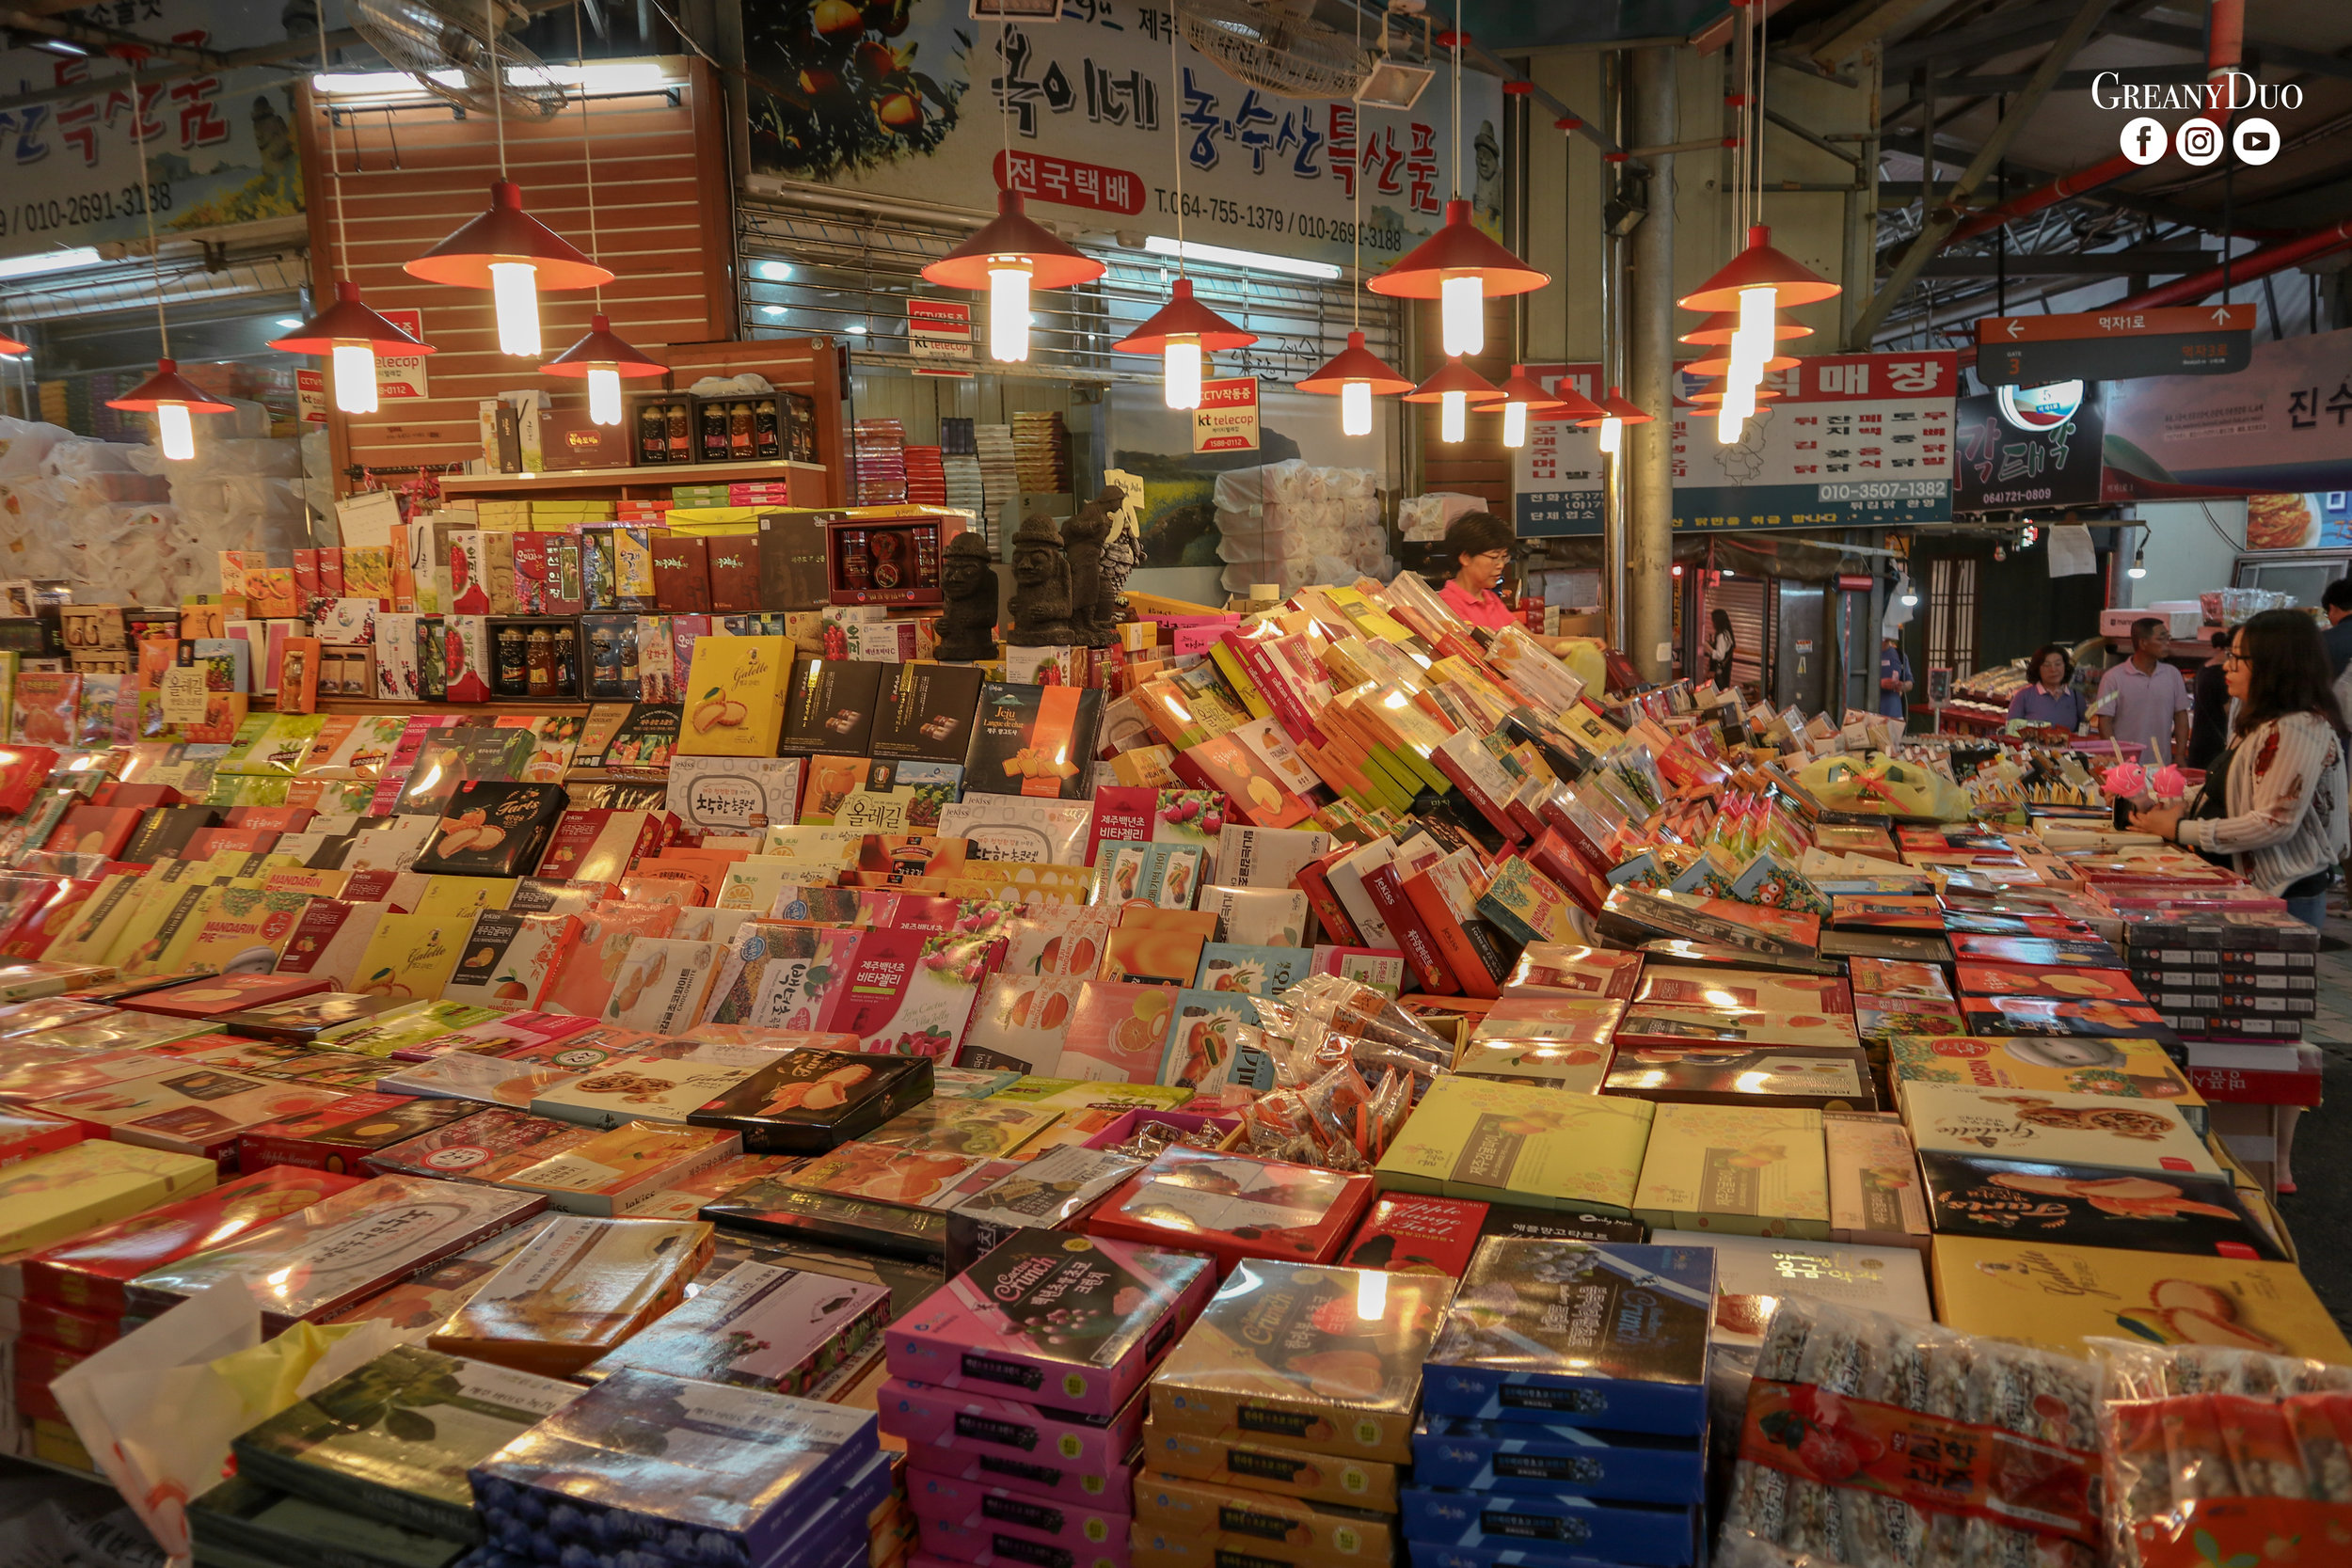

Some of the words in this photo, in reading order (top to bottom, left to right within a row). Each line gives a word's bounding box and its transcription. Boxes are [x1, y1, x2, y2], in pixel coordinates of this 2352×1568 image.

[1138, 8, 1180, 45] 제주
[1327, 103, 1442, 214] 특산품
[1010, 157, 1131, 210] 전국택배
[2098, 315, 2146, 331] 먹자1로
[2009, 357, 2021, 375] 3
[1199, 414, 1213, 427] kt
[1214, 413, 1254, 426] telecop
[1210, 438, 1243, 448] 1588-0112
[1820, 481, 1947, 500] 010-3507-1382
[1751, 515, 1781, 525] 취급
[1791, 513, 1837, 524] 합니다
[732, 661, 770, 693] Galette
[994, 705, 1017, 722] Jeju
[1466, 783, 1488, 806] JeKiss
[495, 800, 541, 818] Tarts
[696, 795, 729, 816] 착한
[846, 797, 901, 830] 올레길
[1100, 815, 1146, 828] 제주백년초
[1099, 826, 1144, 841] 비타젤리
[1237, 830, 1255, 886] 탐나는감귤초
[270, 874, 323, 890] MANDARIN
[659, 871, 689, 881] ORIGINAL
[204, 921, 260, 935] MANDARIN
[474, 925, 515, 939] 제주감귤파이
[197, 931, 216, 944] PIE
[406, 944, 447, 973] Galette
[861, 959, 905, 973] 제주백년초
[856, 972, 901, 986] 비타젤리
[675, 968, 697, 1013] CHOCOWHITE
[1469, 1132, 1502, 1179] 제주감귤파이
[1393, 1209, 1463, 1227] Mango
[1403, 1200, 1462, 1218] Apple
[1399, 1219, 1454, 1234] Tart
[1512, 1222, 1609, 1242] 애플망고타르트
[993, 1256, 1058, 1302] Crunch
[1242, 1292, 1295, 1345] Crunch
